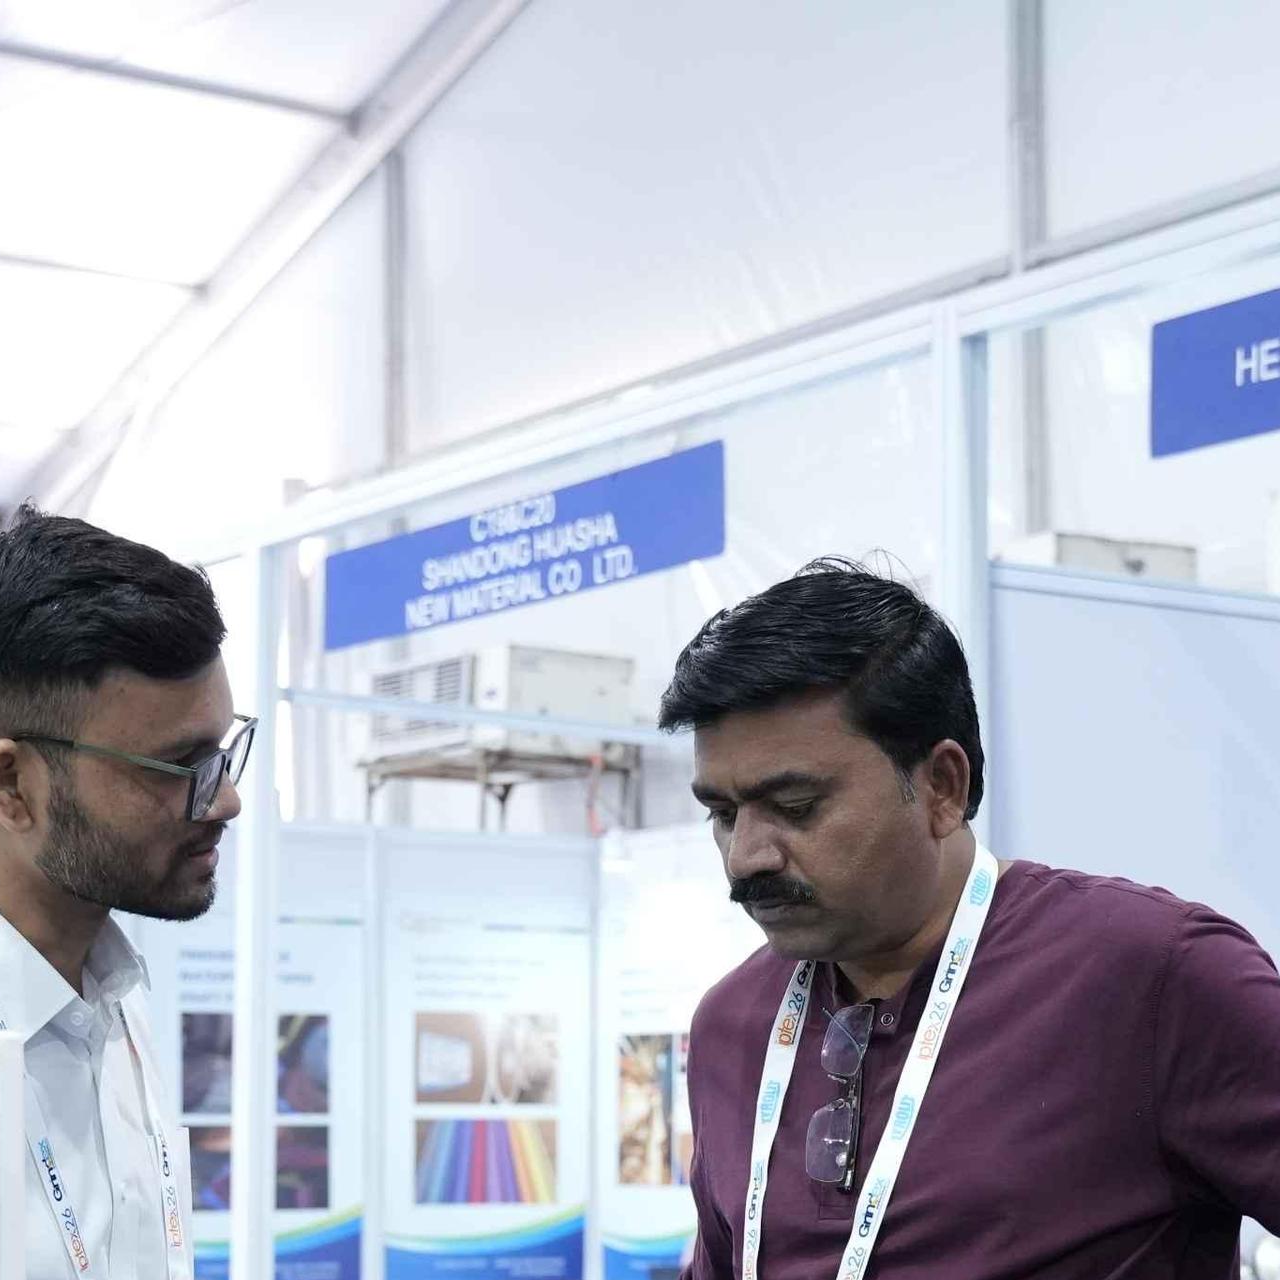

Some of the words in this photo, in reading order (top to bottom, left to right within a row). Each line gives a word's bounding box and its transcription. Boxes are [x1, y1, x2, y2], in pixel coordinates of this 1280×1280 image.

[422, 533, 532, 591] SHANDONG
[405, 594, 449, 631] NEW
[451, 569, 547, 618] MATERIAL
